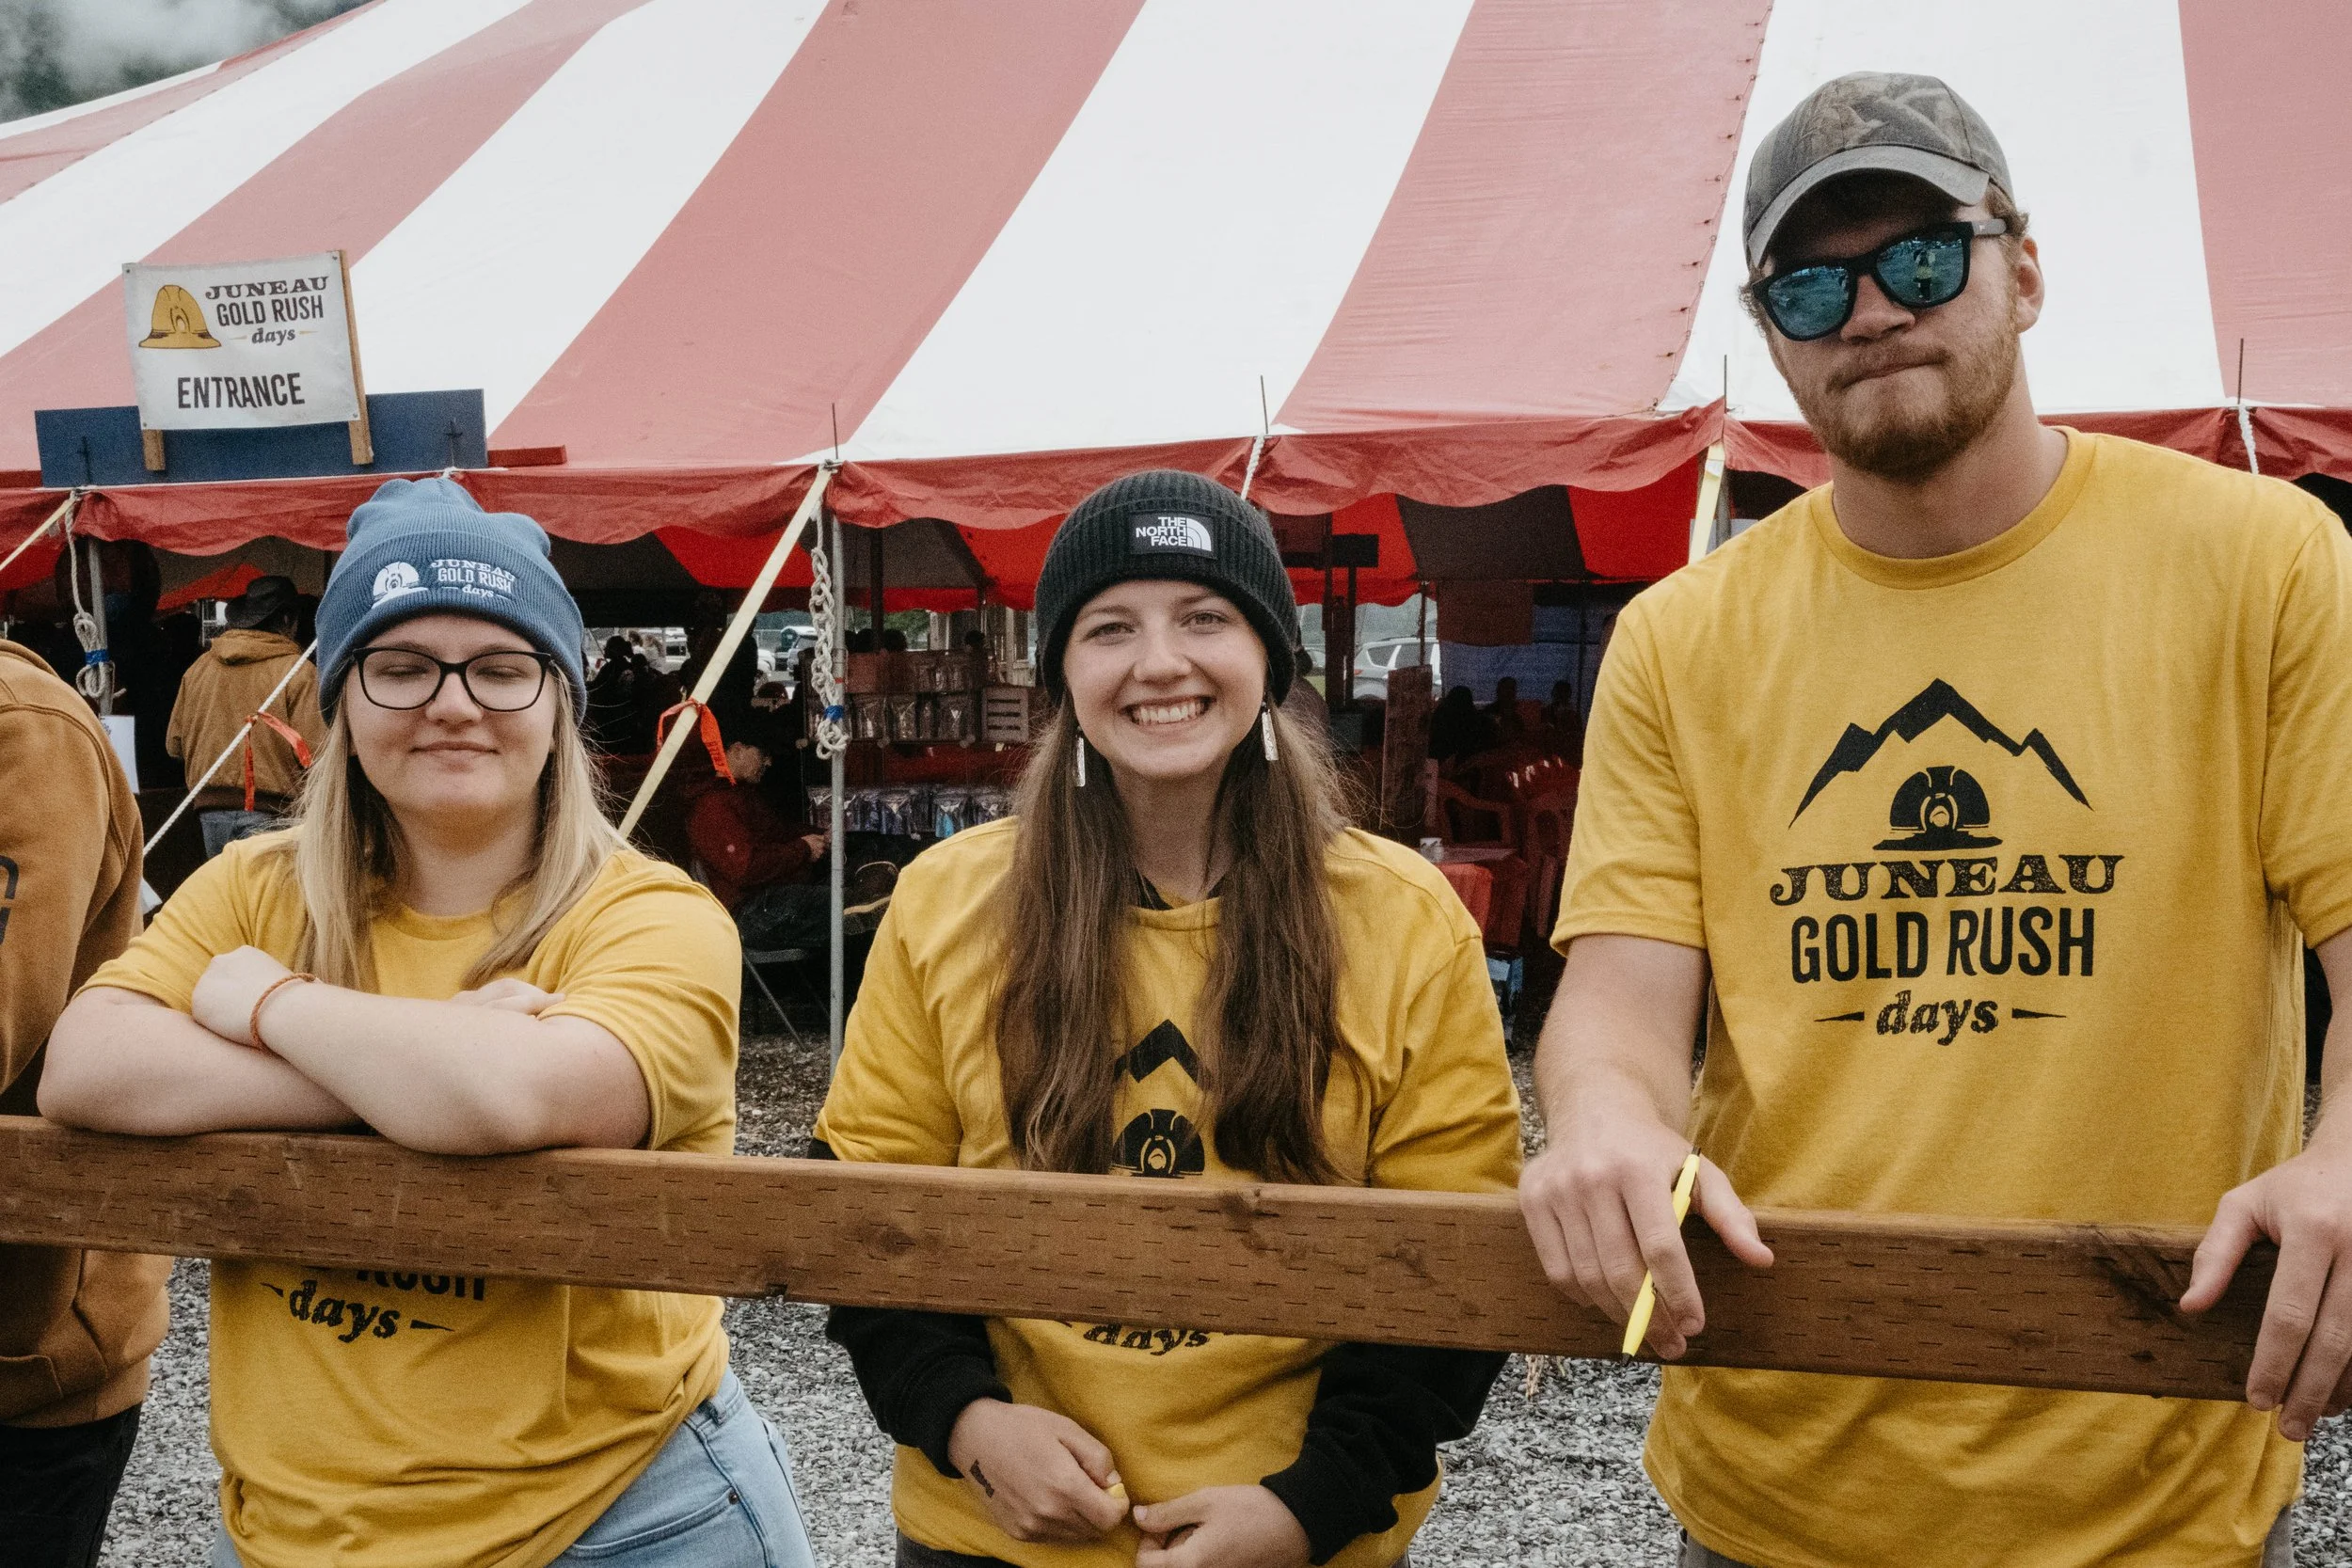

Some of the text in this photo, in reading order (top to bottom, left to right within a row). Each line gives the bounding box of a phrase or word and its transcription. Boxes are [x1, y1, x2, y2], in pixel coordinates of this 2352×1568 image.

[205, 276, 329, 300] JUNEAU
[216, 294, 324, 326] GOLD RUSH
[251, 326, 296, 346] days
[178, 372, 305, 409] ENTRANCE
[1136, 526, 1186, 538] NORTH
[1158, 516, 1186, 527] THE
[1151, 535, 1187, 546] FACE
[430, 559, 516, 581] JUNEAU
[437, 566, 515, 593] GOLD RUSH
[462, 584, 495, 598] days
[1769, 853, 2125, 907] JUNEAU
[1791, 906, 2095, 985] GOLD RUSH
[1876, 990, 1999, 1046] days
[289, 1279, 401, 1343] days
